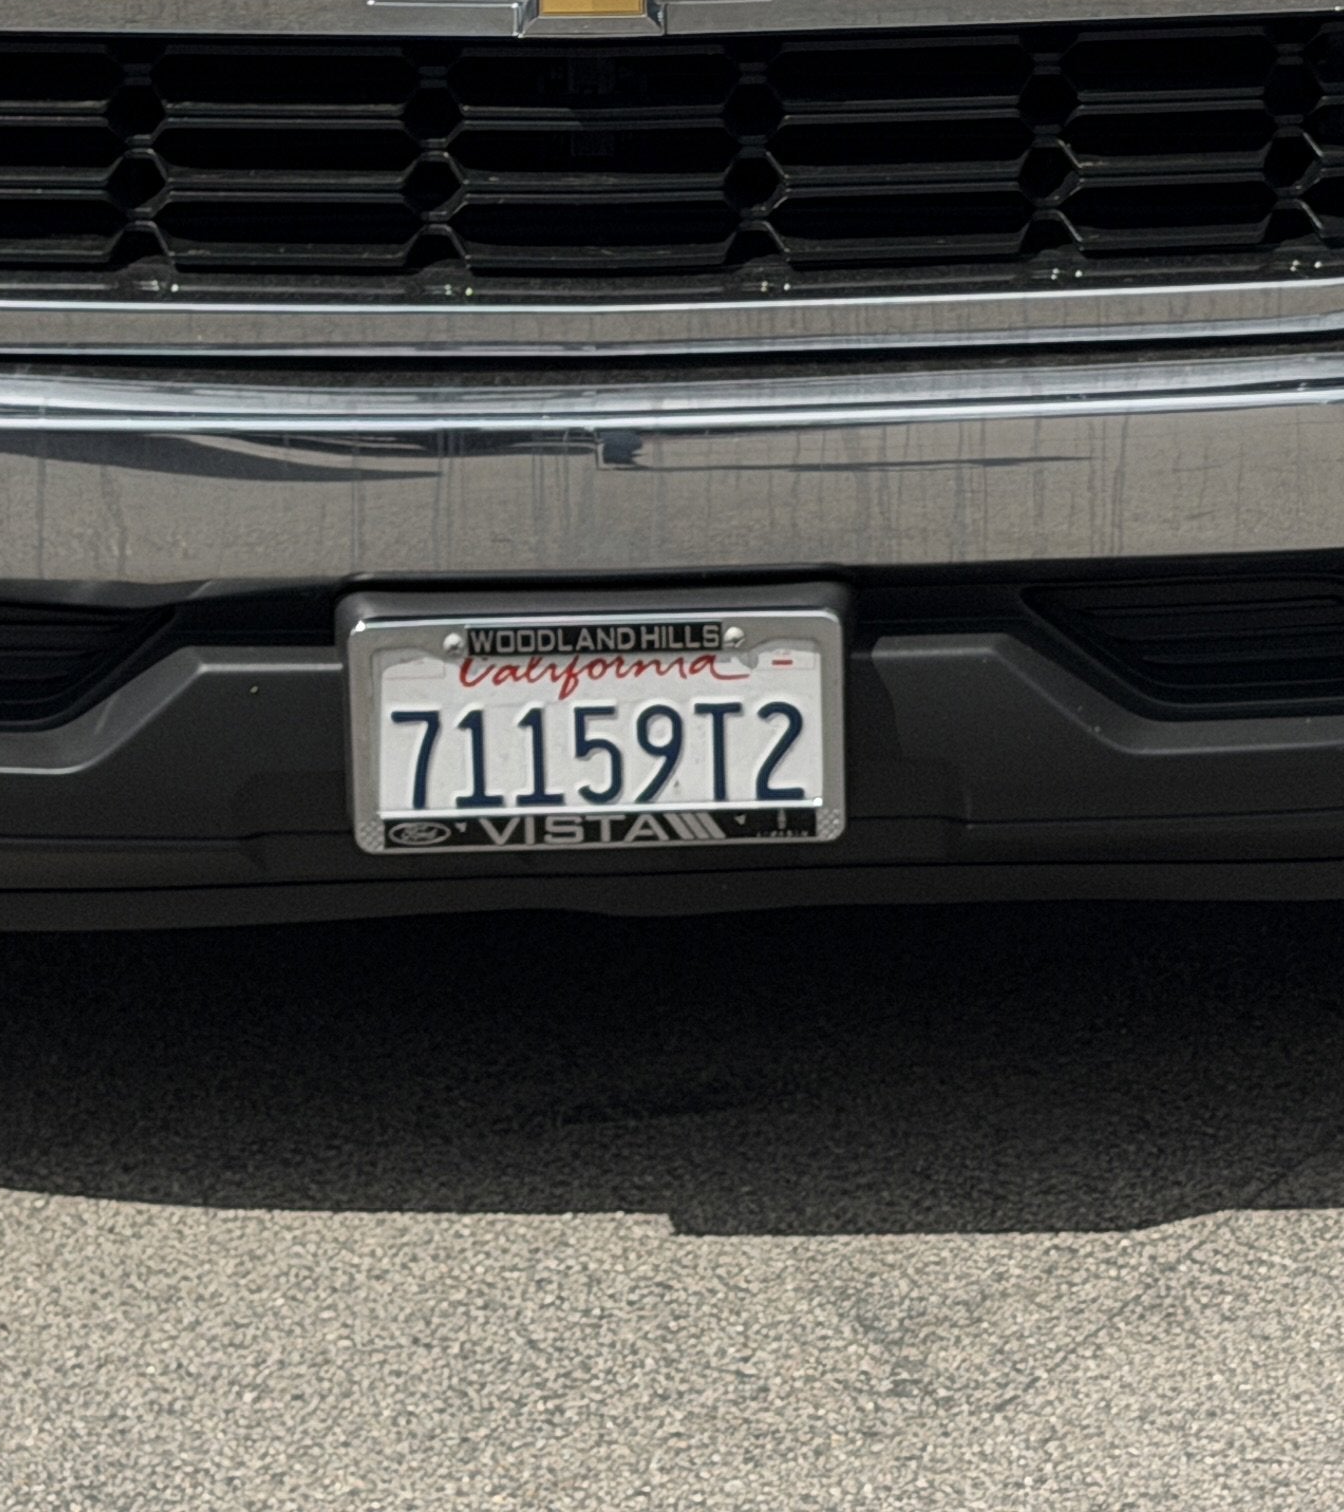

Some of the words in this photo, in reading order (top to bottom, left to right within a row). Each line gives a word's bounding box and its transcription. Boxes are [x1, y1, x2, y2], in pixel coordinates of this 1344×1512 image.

[469, 626, 635, 654] WOODLAND
[642, 624, 721, 649] HILLS
[459, 653, 750, 701] California
[391, 701, 806, 810] 71159T2
[478, 812, 669, 845] VISTA
